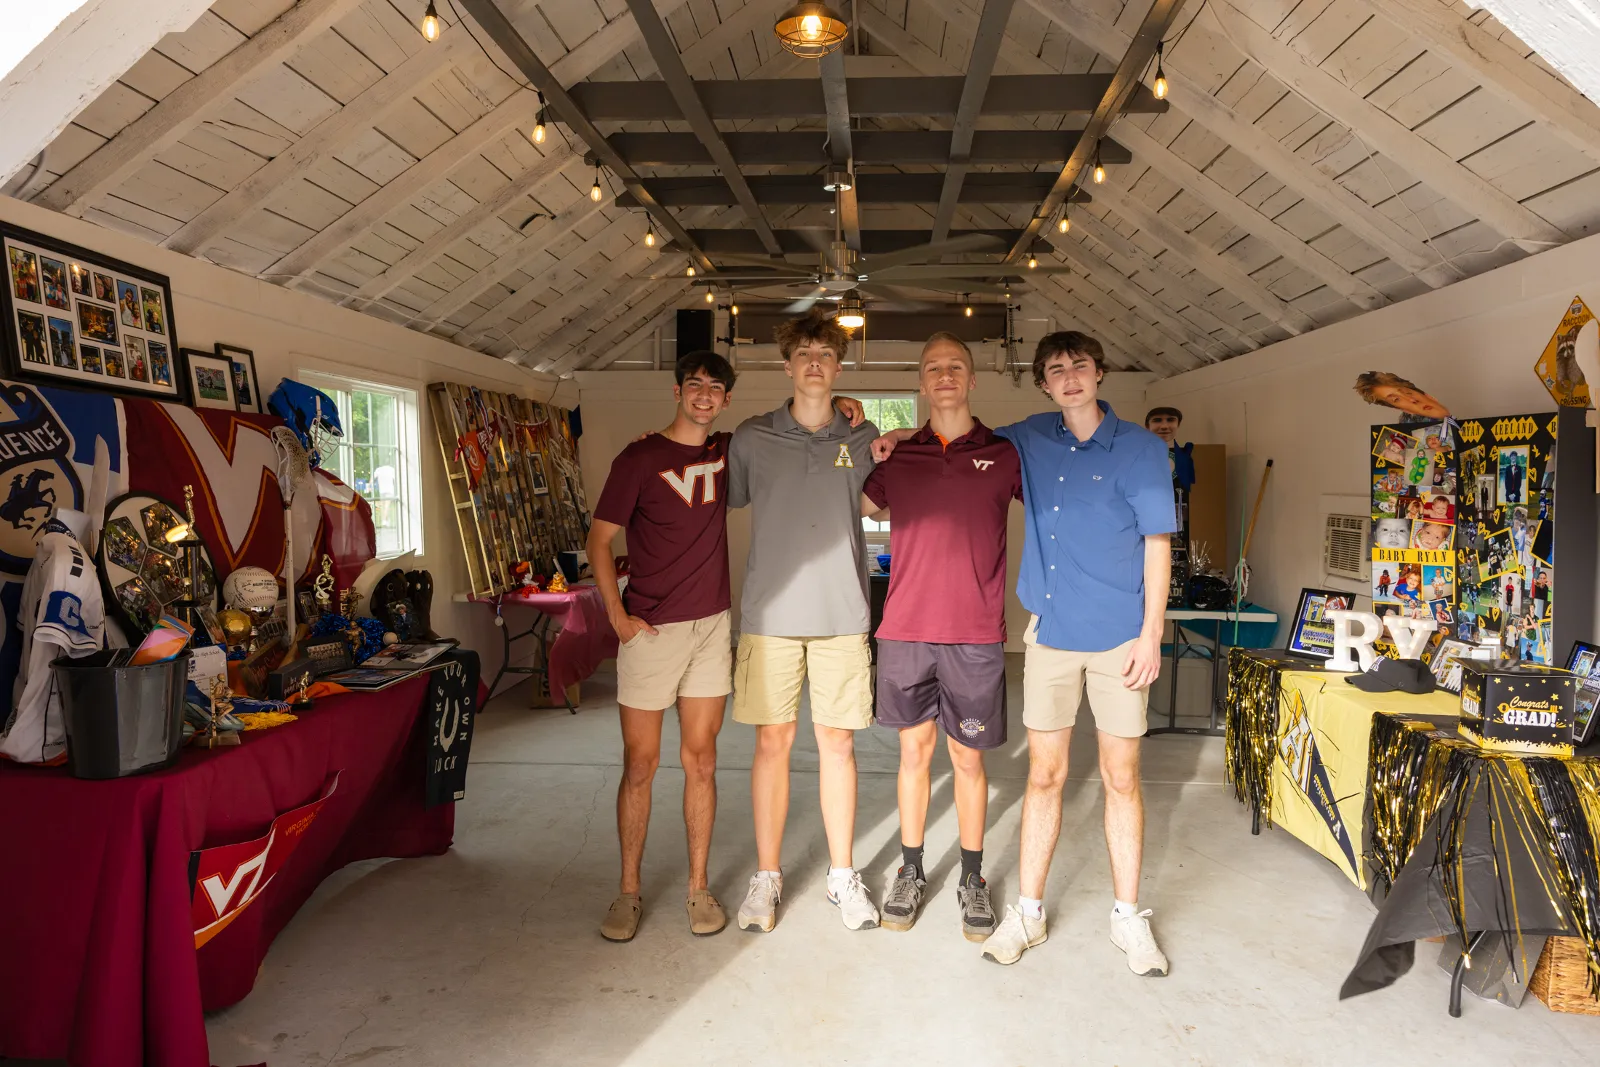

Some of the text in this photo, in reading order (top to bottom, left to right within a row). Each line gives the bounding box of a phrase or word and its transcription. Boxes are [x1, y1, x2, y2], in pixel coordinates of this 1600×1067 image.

[1562, 314, 1591, 328] RACCOON
[1461, 423, 1481, 437] RYAN
[1494, 420, 1534, 436] LEELAND
[834, 443, 854, 468] A
[972, 458, 995, 471] VT
[658, 455, 725, 508] VT
[1379, 549, 1447, 563] BABY RYAN
[433, 662, 471, 747] MAKE YOUR OWN
[1509, 695, 1549, 709] Congrats
[1503, 711, 1557, 728] GRAD!
